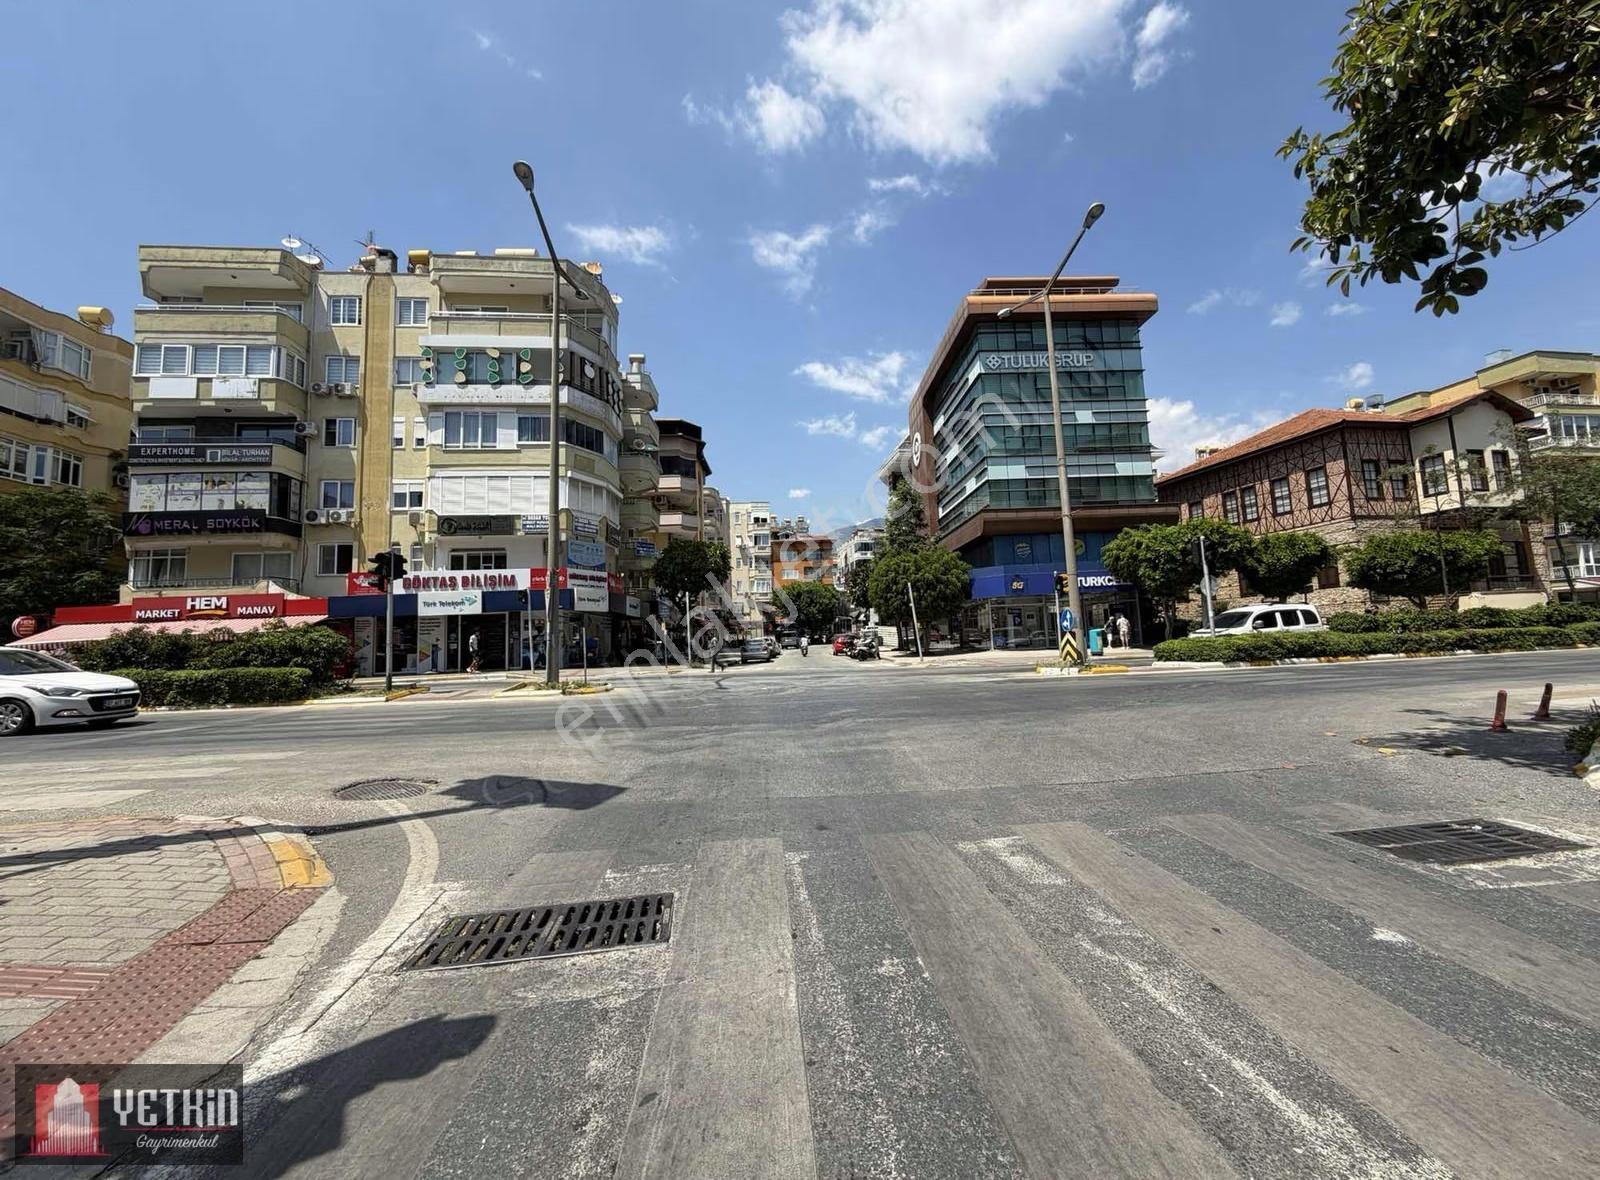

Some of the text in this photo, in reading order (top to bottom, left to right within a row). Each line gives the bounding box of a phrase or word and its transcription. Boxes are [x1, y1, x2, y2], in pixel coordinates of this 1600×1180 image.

[1002, 353, 1094, 368] TULUK GRUP
[141, 447, 196, 456] EXPERTHOME
[153, 515, 260, 530] MERAL SOYKÖK
[461, 573, 517, 590] BİLİŞİM
[187, 596, 228, 610] HEM
[439, 599, 466, 609] Telekom
[136, 609, 180, 619] MARKET
[237, 605, 275, 615] MANAV
